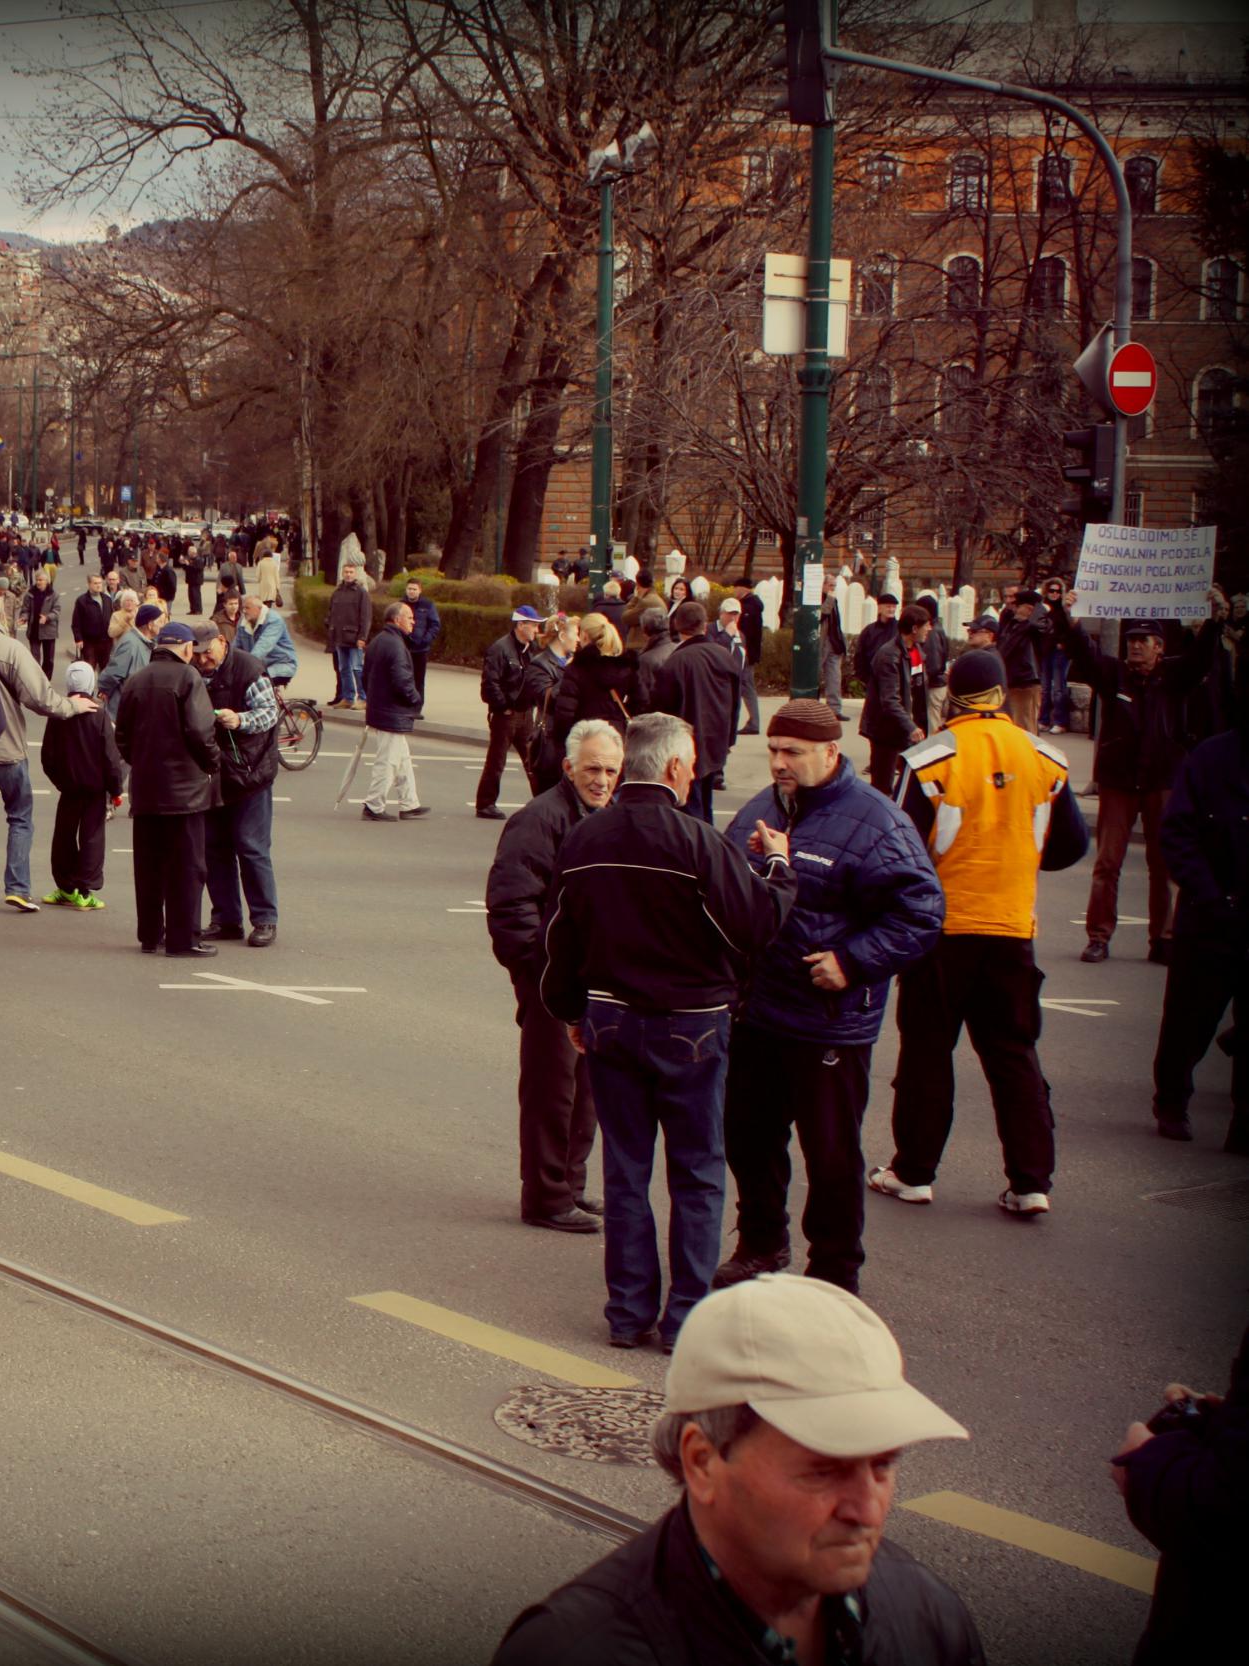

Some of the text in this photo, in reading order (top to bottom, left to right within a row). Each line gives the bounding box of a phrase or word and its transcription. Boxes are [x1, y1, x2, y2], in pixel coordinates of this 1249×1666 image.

[1098, 525, 1199, 542] OSLOBODIMO SE
[1085, 543, 1211, 560] NACIONALNIH PODJELA
[1081, 561, 1205, 577] PLEMENSKIH POGLAVICA
[1096, 605, 1131, 617] SVIMA
[1150, 606, 1170, 618] BITI
[1174, 606, 1206, 617] DOBRO
